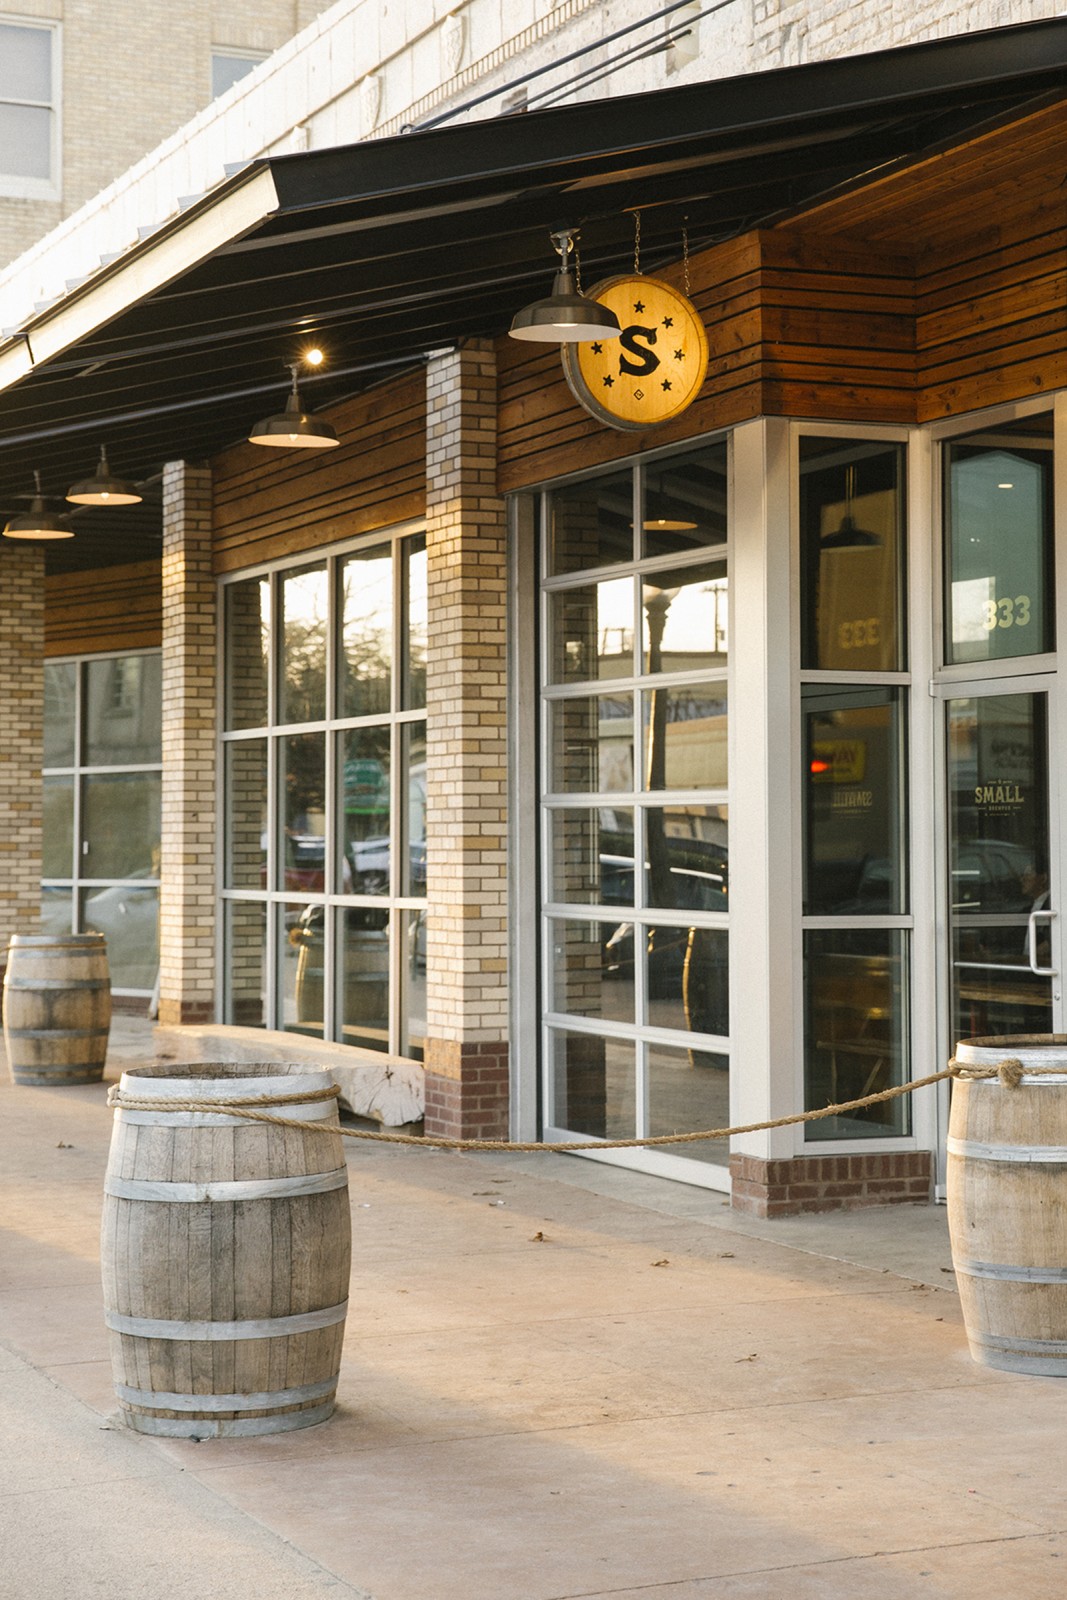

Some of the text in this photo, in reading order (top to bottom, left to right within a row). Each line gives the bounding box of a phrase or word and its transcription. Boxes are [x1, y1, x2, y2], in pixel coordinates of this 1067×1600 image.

[619, 325, 661, 376] S
[982, 595, 1030, 630] 333
[975, 785, 1025, 804] SMALL
